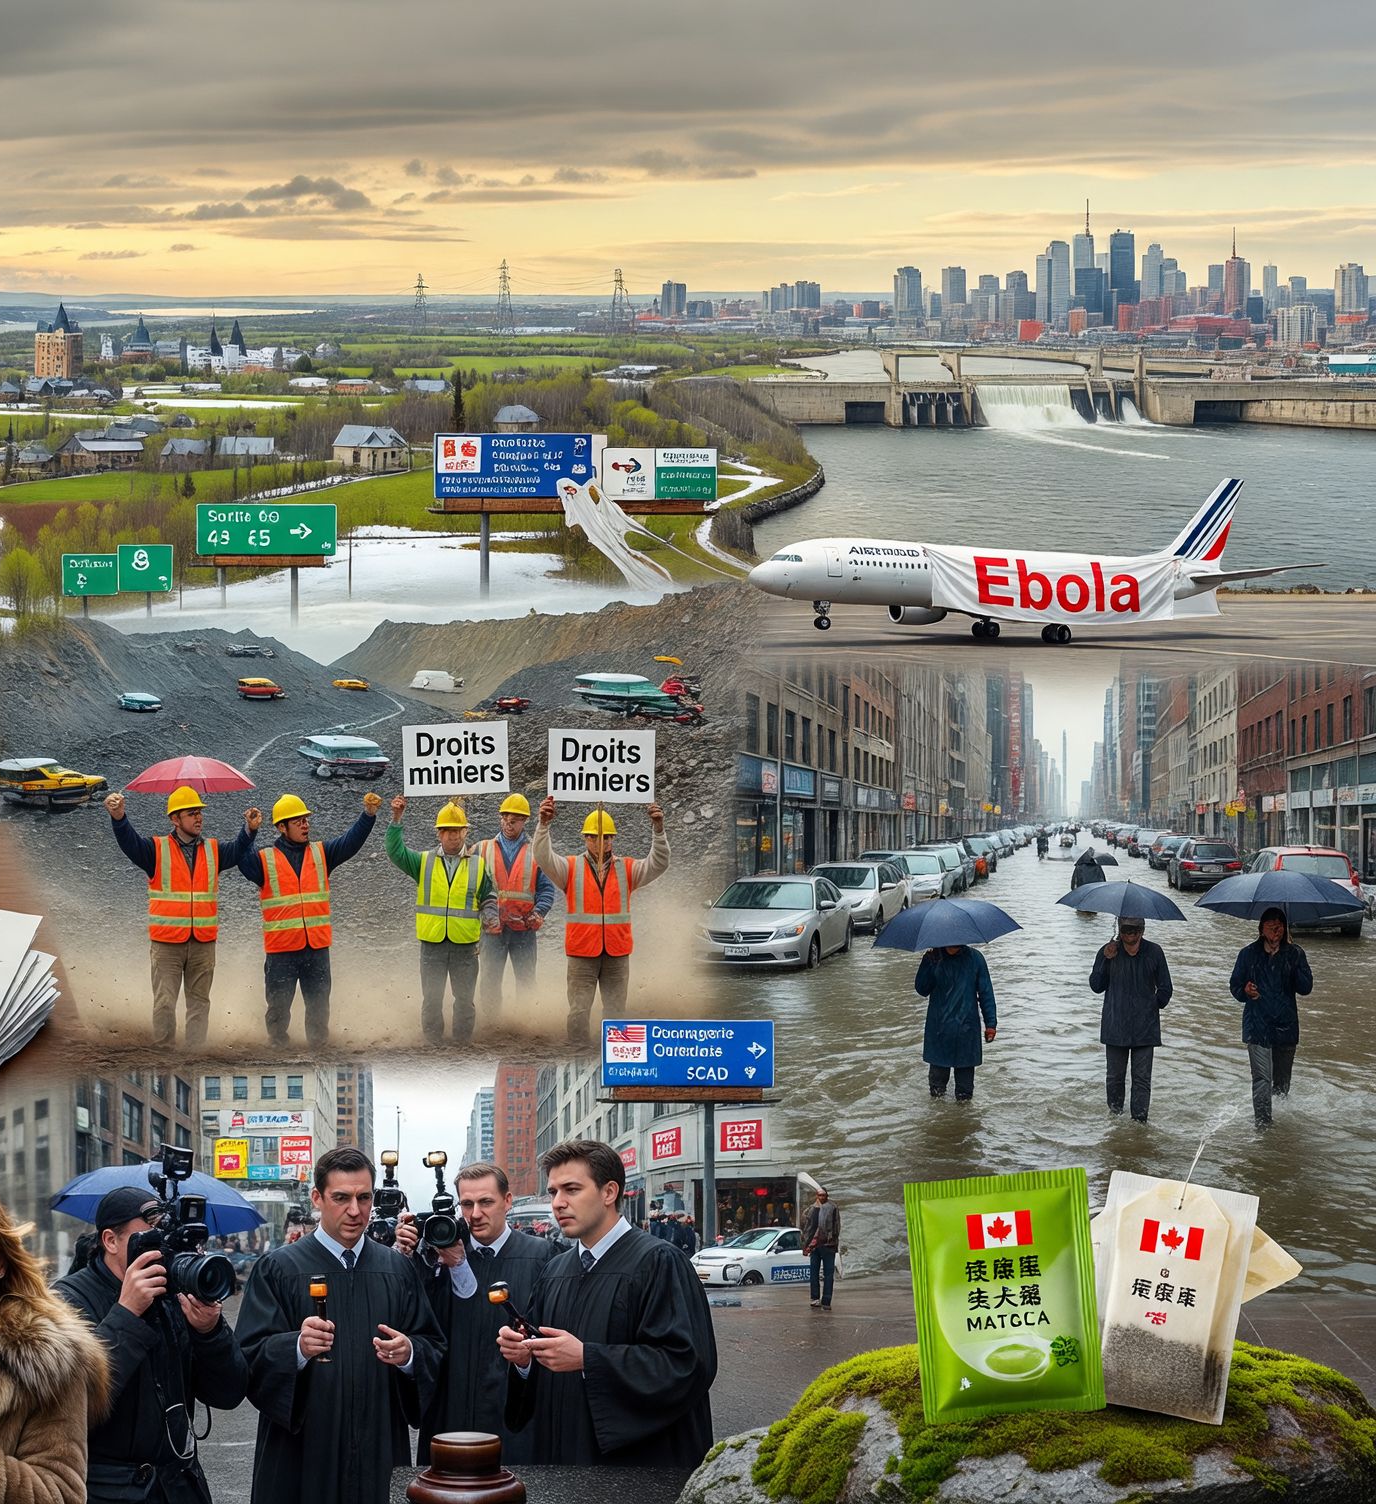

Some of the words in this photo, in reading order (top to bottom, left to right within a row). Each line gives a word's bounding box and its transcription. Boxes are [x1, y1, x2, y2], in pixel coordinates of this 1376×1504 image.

[973, 555, 1141, 613] Ebola
[416, 730, 496, 757] Droits
[561, 737, 641, 764] Droits
[409, 758, 505, 785] miniers
[553, 766, 650, 793] miniers
